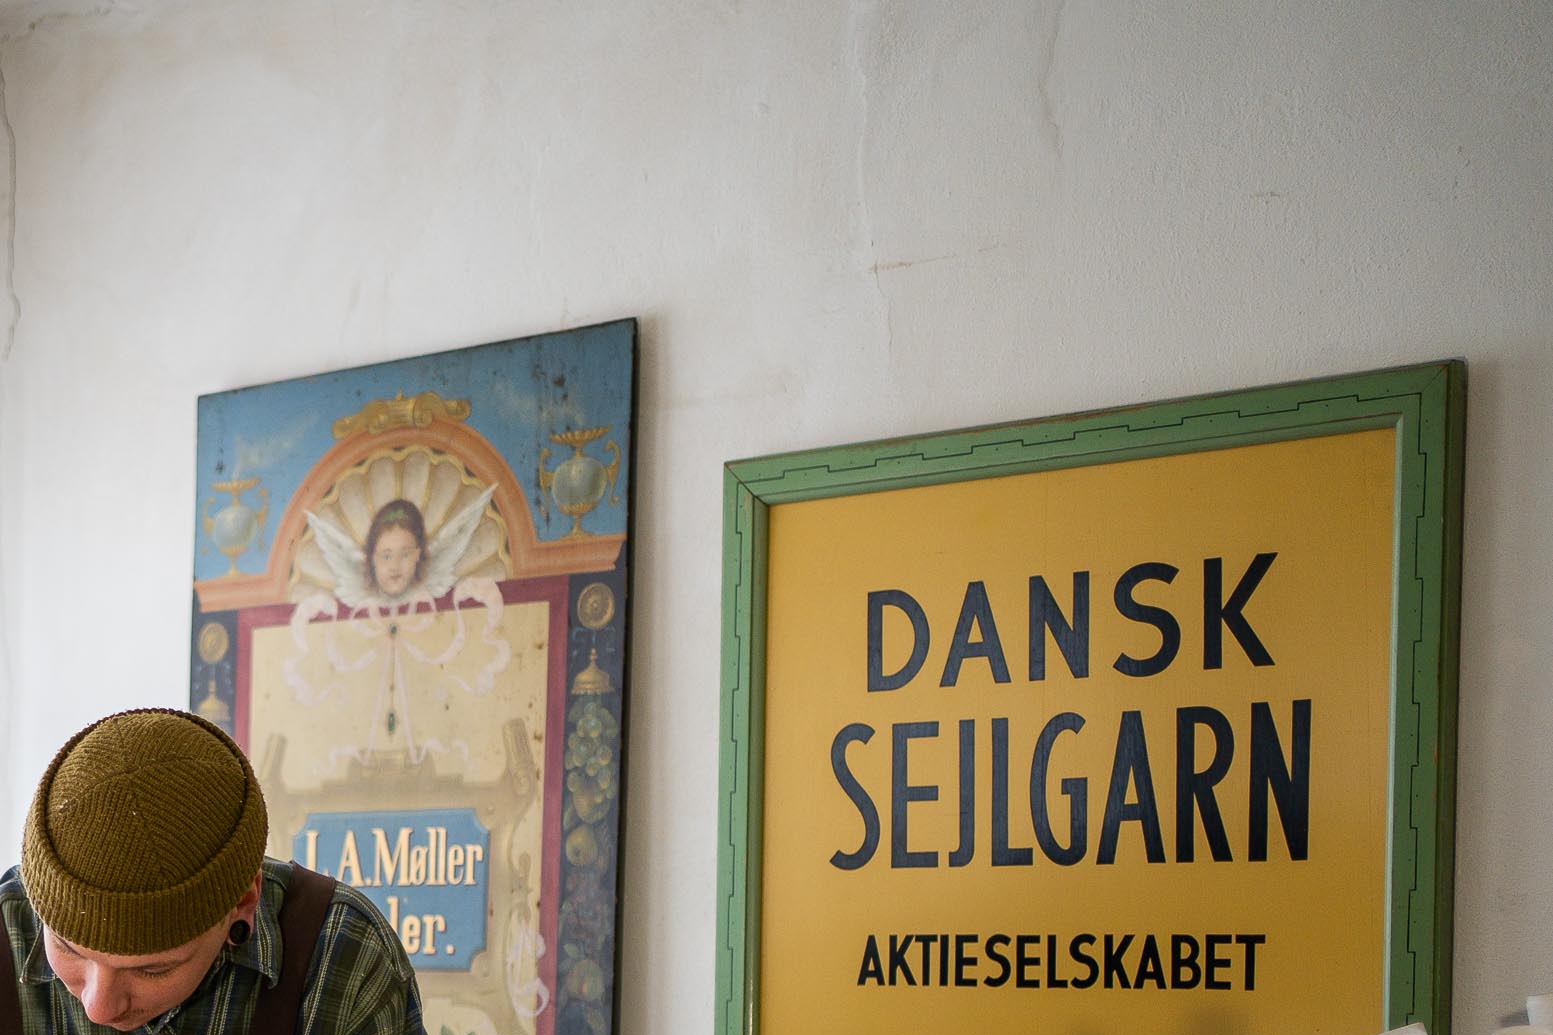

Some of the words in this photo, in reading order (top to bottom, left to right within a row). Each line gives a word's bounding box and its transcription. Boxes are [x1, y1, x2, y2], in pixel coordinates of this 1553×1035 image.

[866, 551, 1279, 693] DANSK
[828, 698, 1312, 871] SEJLGARN
[856, 933, 1266, 992] AKTIESELSKABET
